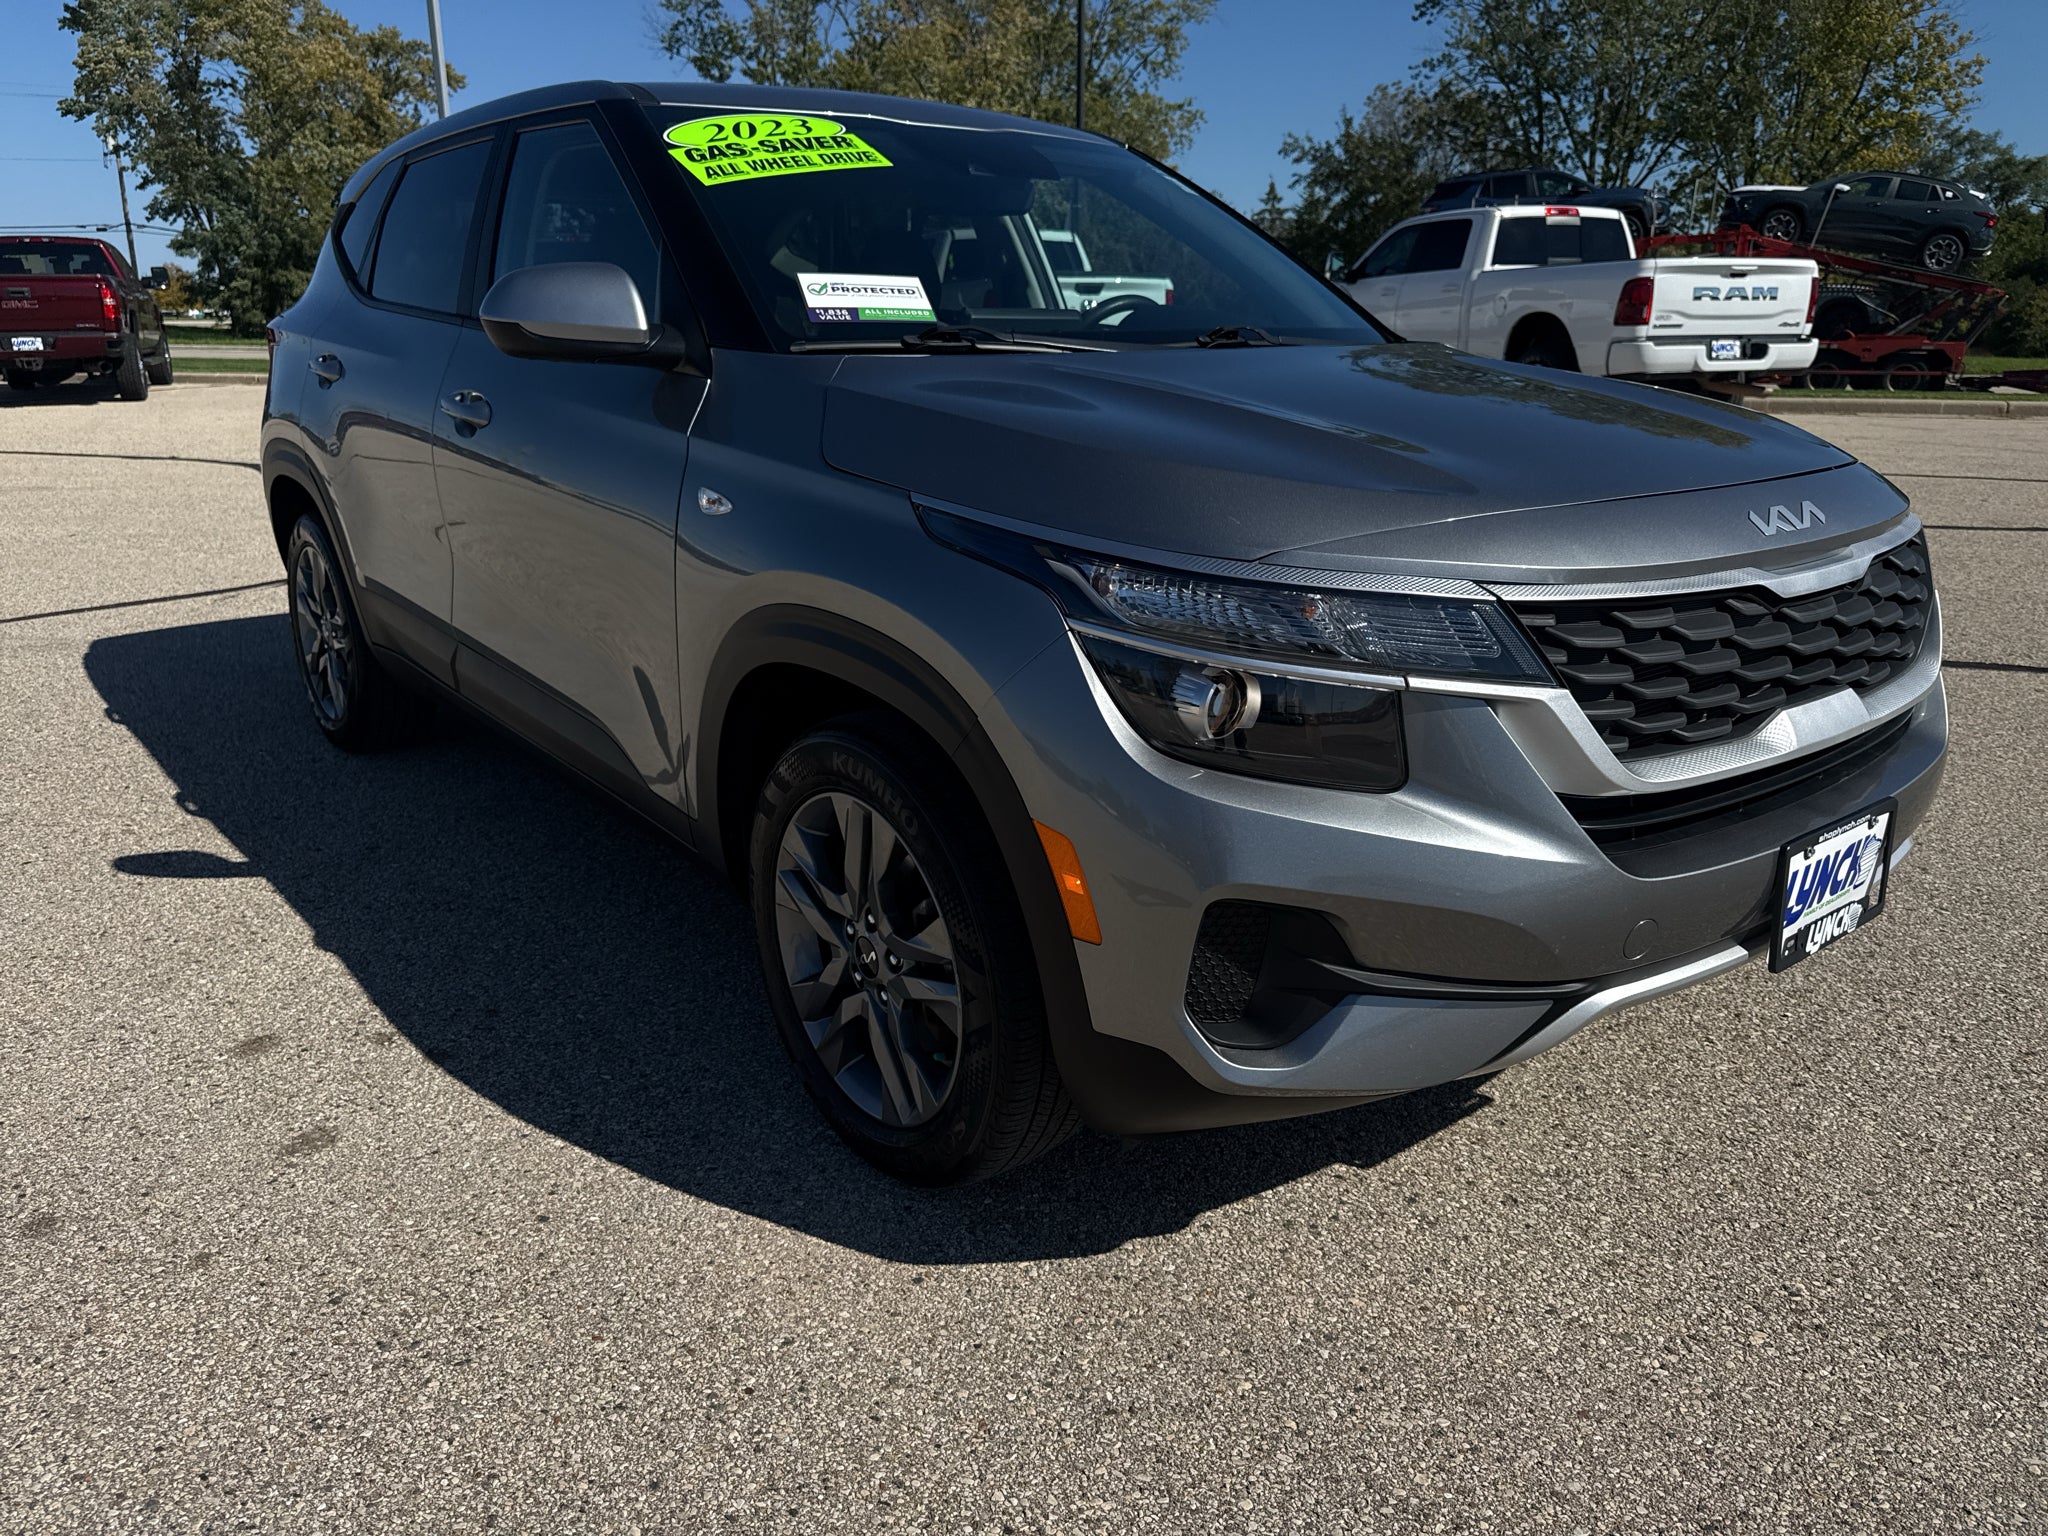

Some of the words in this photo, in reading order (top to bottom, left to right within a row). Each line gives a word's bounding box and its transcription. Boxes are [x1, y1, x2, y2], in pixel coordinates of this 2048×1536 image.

[703, 118, 813, 144] 2023
[683, 135, 855, 165] GAS-SAVER
[703, 163, 747, 181] ALL
[744, 156, 817, 174] WHEEL
[816, 151, 881, 168] DRIVE
[1, 300, 39, 309] GMC
[831, 286, 916, 296] PROTECTED
[1692, 287, 1779, 301] RAM
[12, 339, 37, 348] LYNCH
[1711, 343, 1736, 354] LYNCH
[1748, 500, 1826, 536] KIA
[831, 751, 919, 836] KUMHO
[1818, 814, 1872, 843] shoplynch.com
[1783, 834, 1872, 928] LYNCH
[1805, 903, 1851, 955] LYNCH
